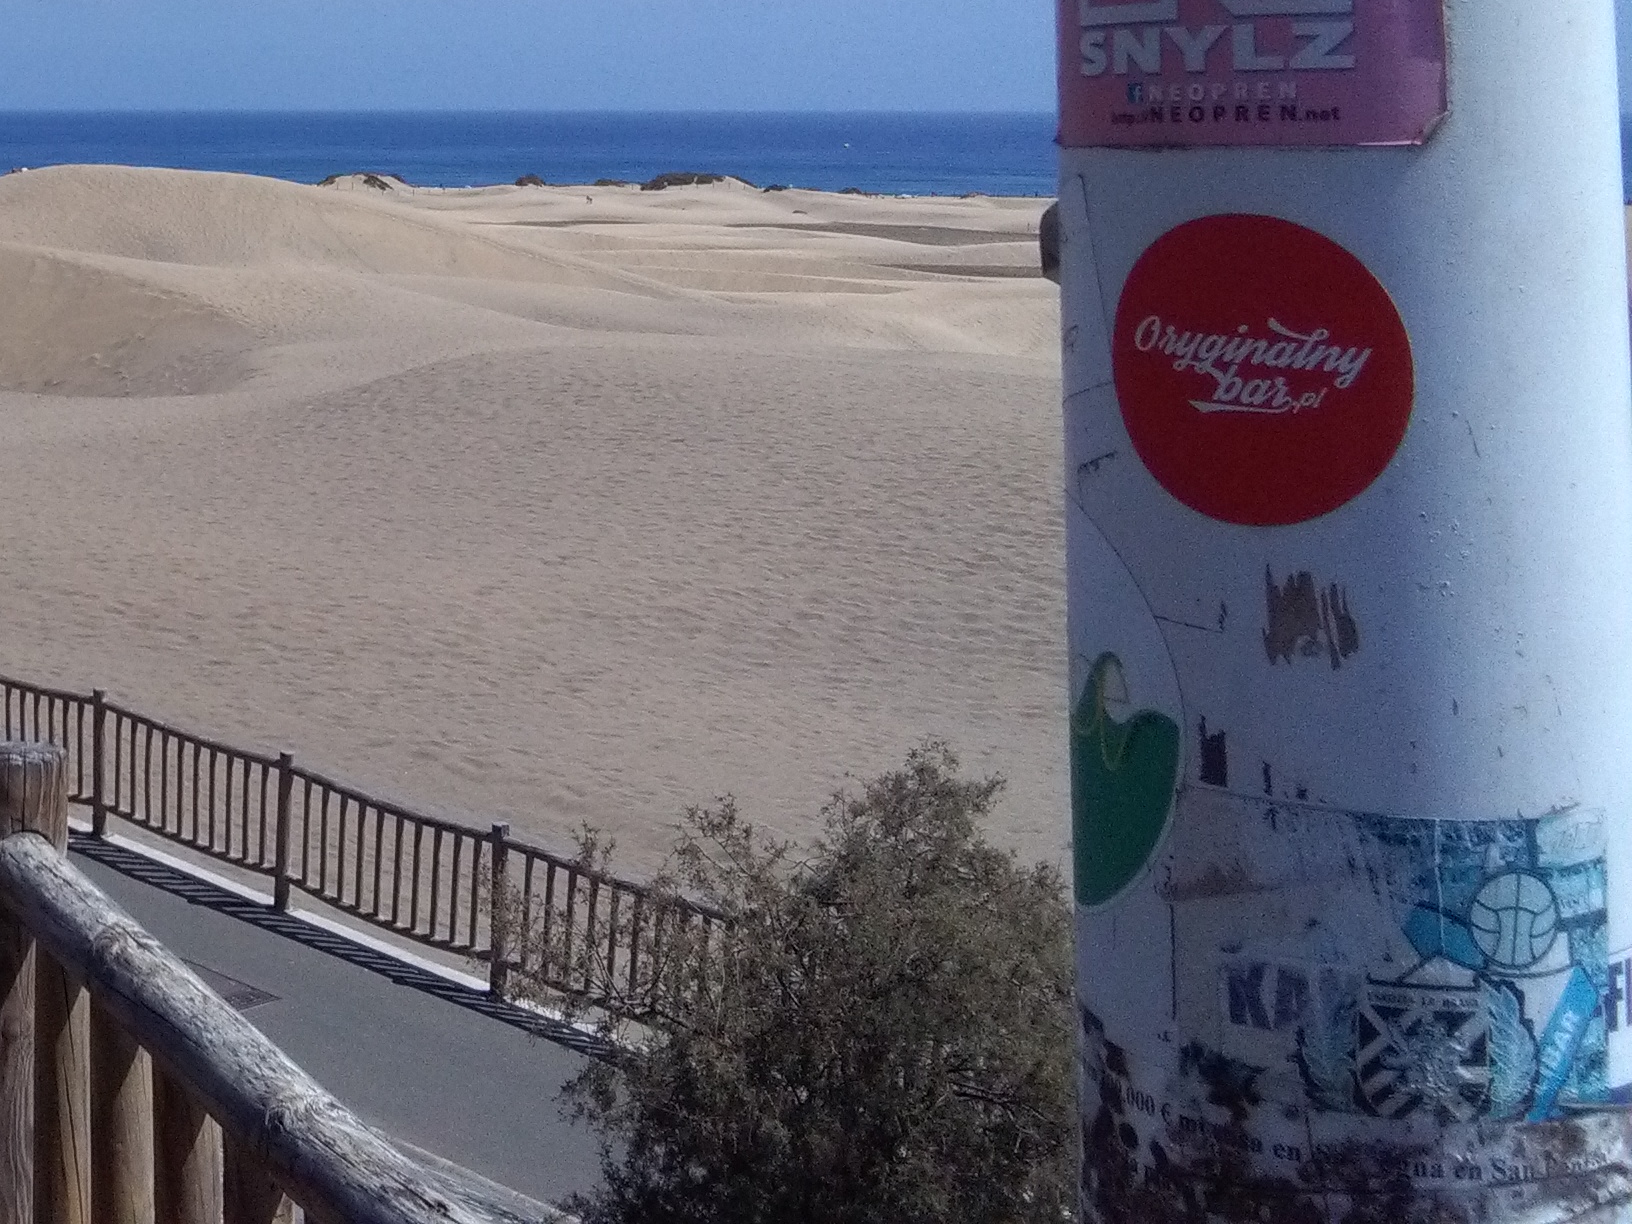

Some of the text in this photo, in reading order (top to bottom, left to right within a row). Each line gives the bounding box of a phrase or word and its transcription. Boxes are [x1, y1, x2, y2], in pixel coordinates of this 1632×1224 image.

[1080, 21, 1356, 77] SNYLZ
[1148, 81, 1297, 103] NEOPREN
[1134, 314, 1373, 388] Oryginalny
